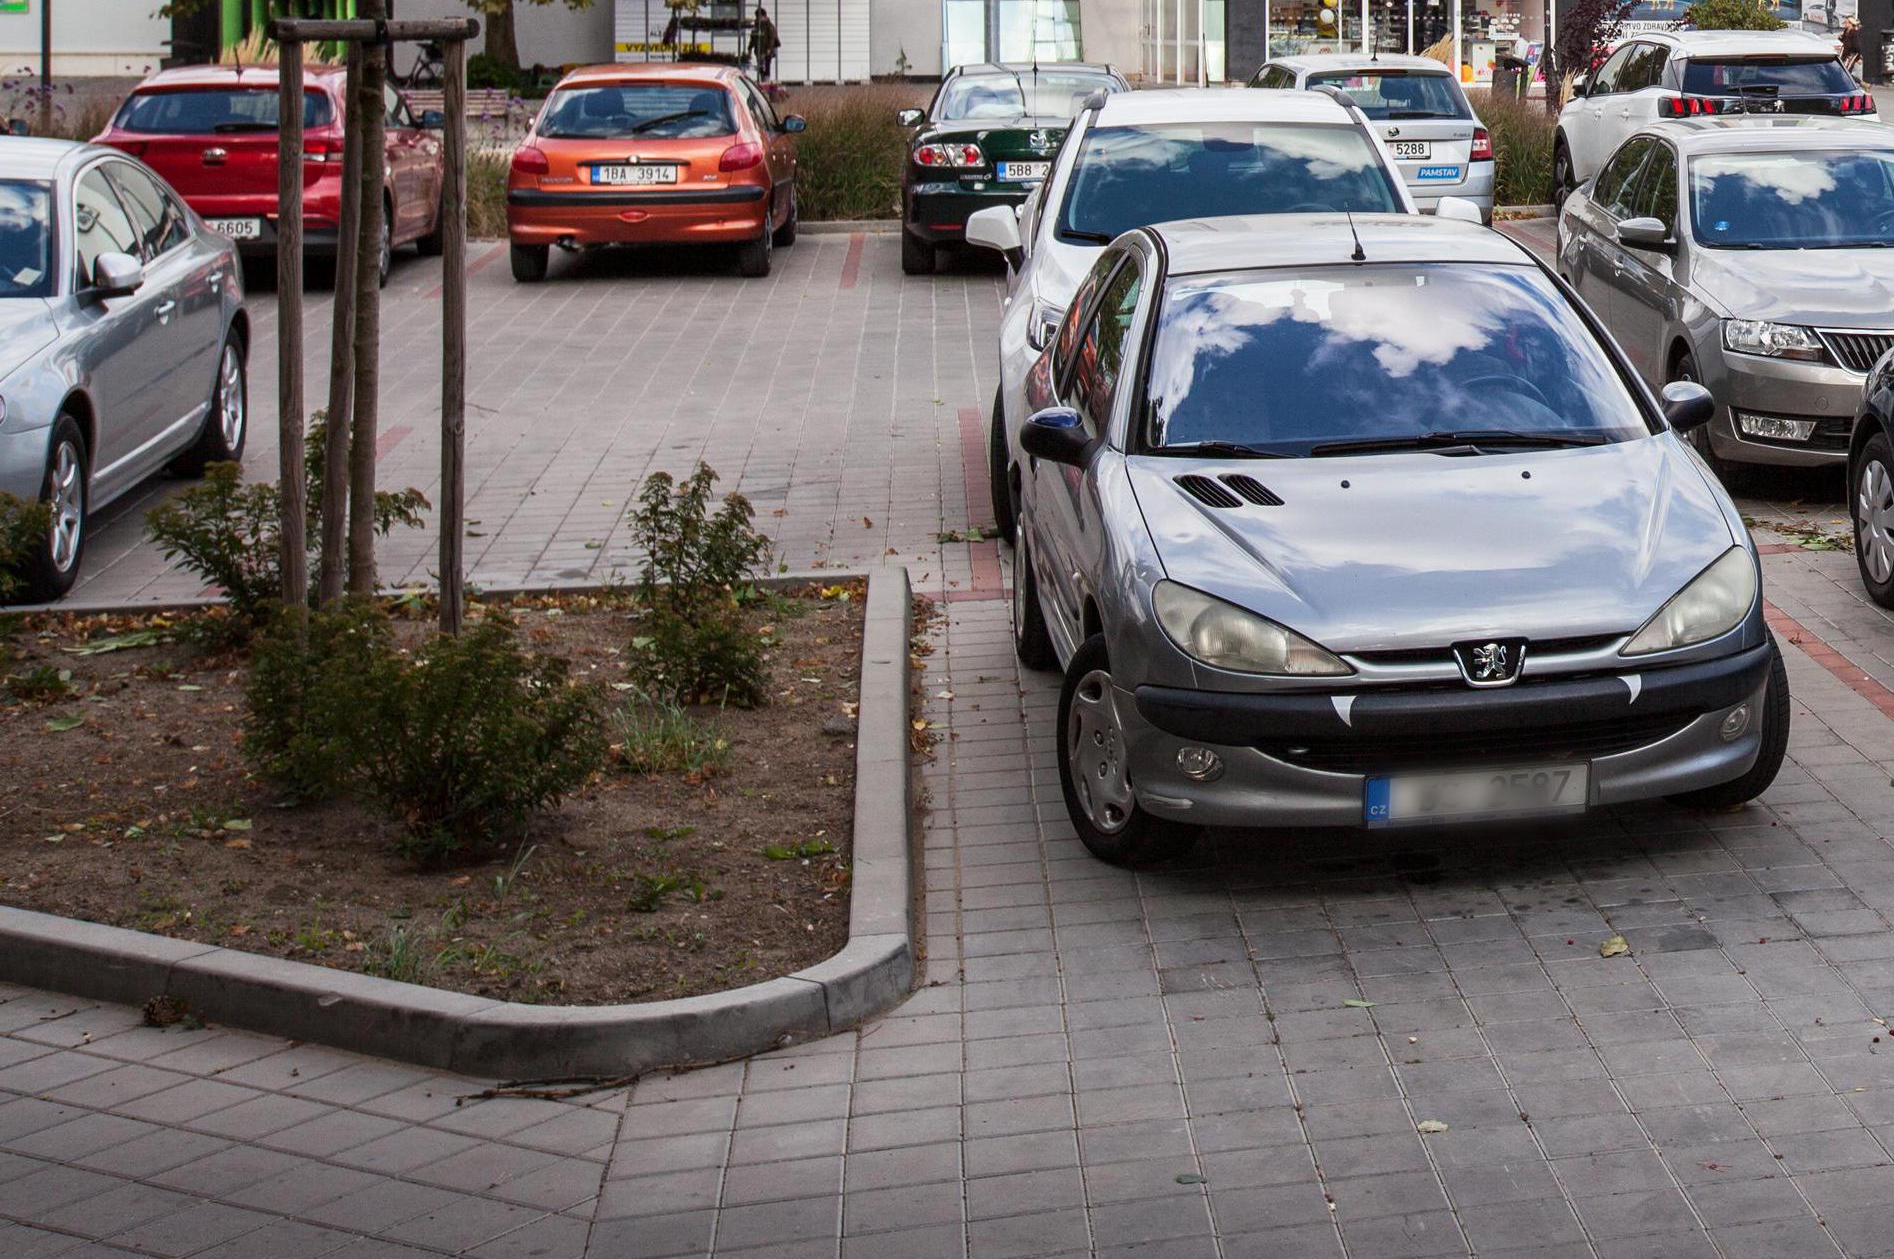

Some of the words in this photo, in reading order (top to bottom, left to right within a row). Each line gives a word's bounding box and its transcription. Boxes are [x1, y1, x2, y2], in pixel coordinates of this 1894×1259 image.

[1396, 143, 1425, 155] 5288
[604, 167, 626, 180] 1BA
[638, 167, 669, 180] 3914
[1008, 164, 1032, 177] 5B8
[1420, 168, 1457, 177] PAMSTAV
[217, 222, 253, 234] 6605
[1370, 804, 1387, 816] CZ
